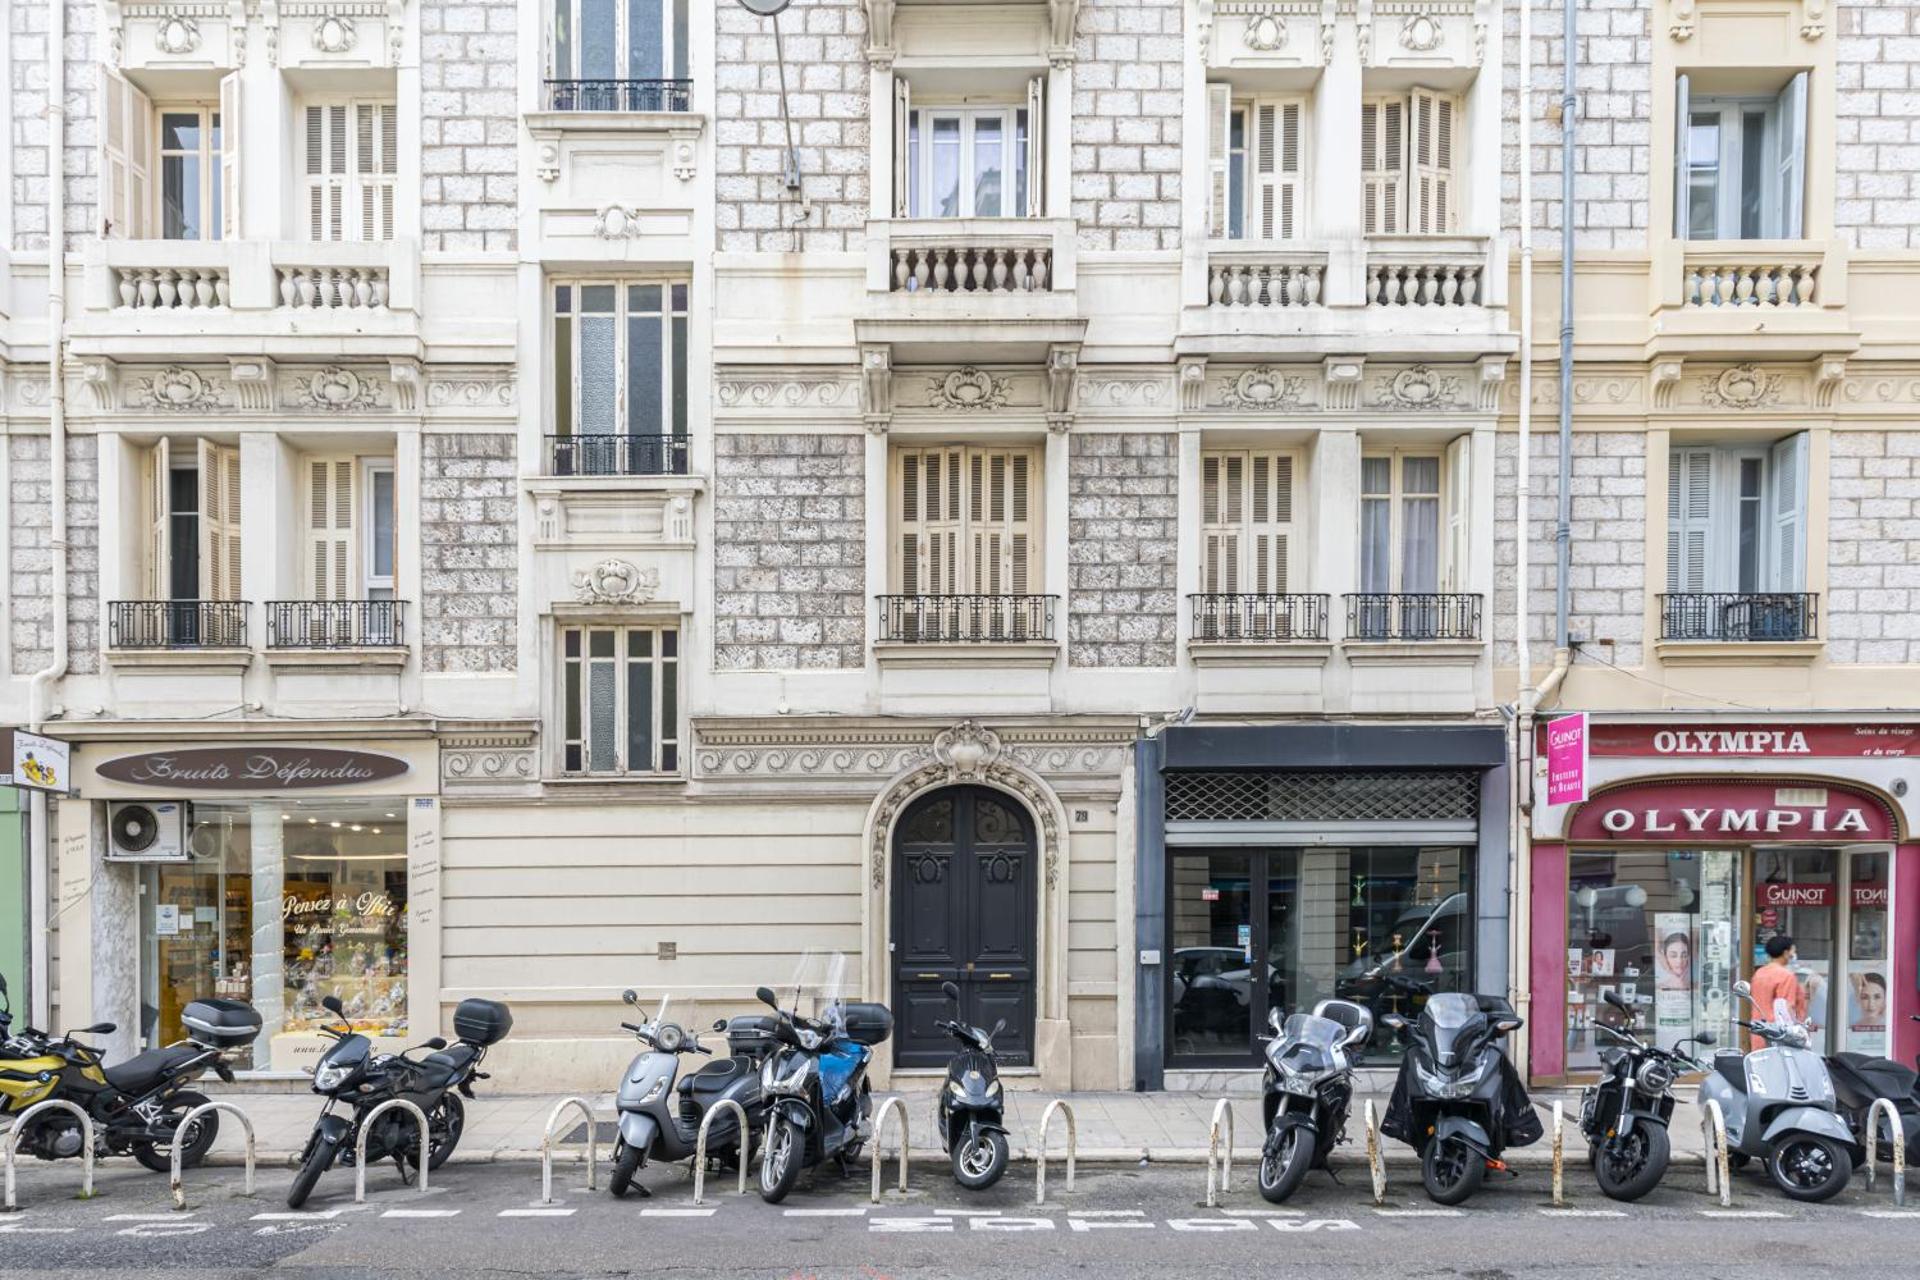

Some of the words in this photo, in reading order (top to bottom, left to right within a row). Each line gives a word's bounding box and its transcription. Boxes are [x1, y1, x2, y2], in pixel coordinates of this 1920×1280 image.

[1550, 727, 1582, 747] GUINOT
[1653, 730, 1811, 754] OLYMPIA
[131, 755, 231, 780] Fruits
[239, 754, 375, 786] Défendus
[1601, 807, 1871, 833] OLYMPIA
[1766, 884, 1827, 901] GUINOT
[280, 895, 331, 921] Pensez
[336, 892, 348, 910] à
[355, 890, 396, 917] Offrir
